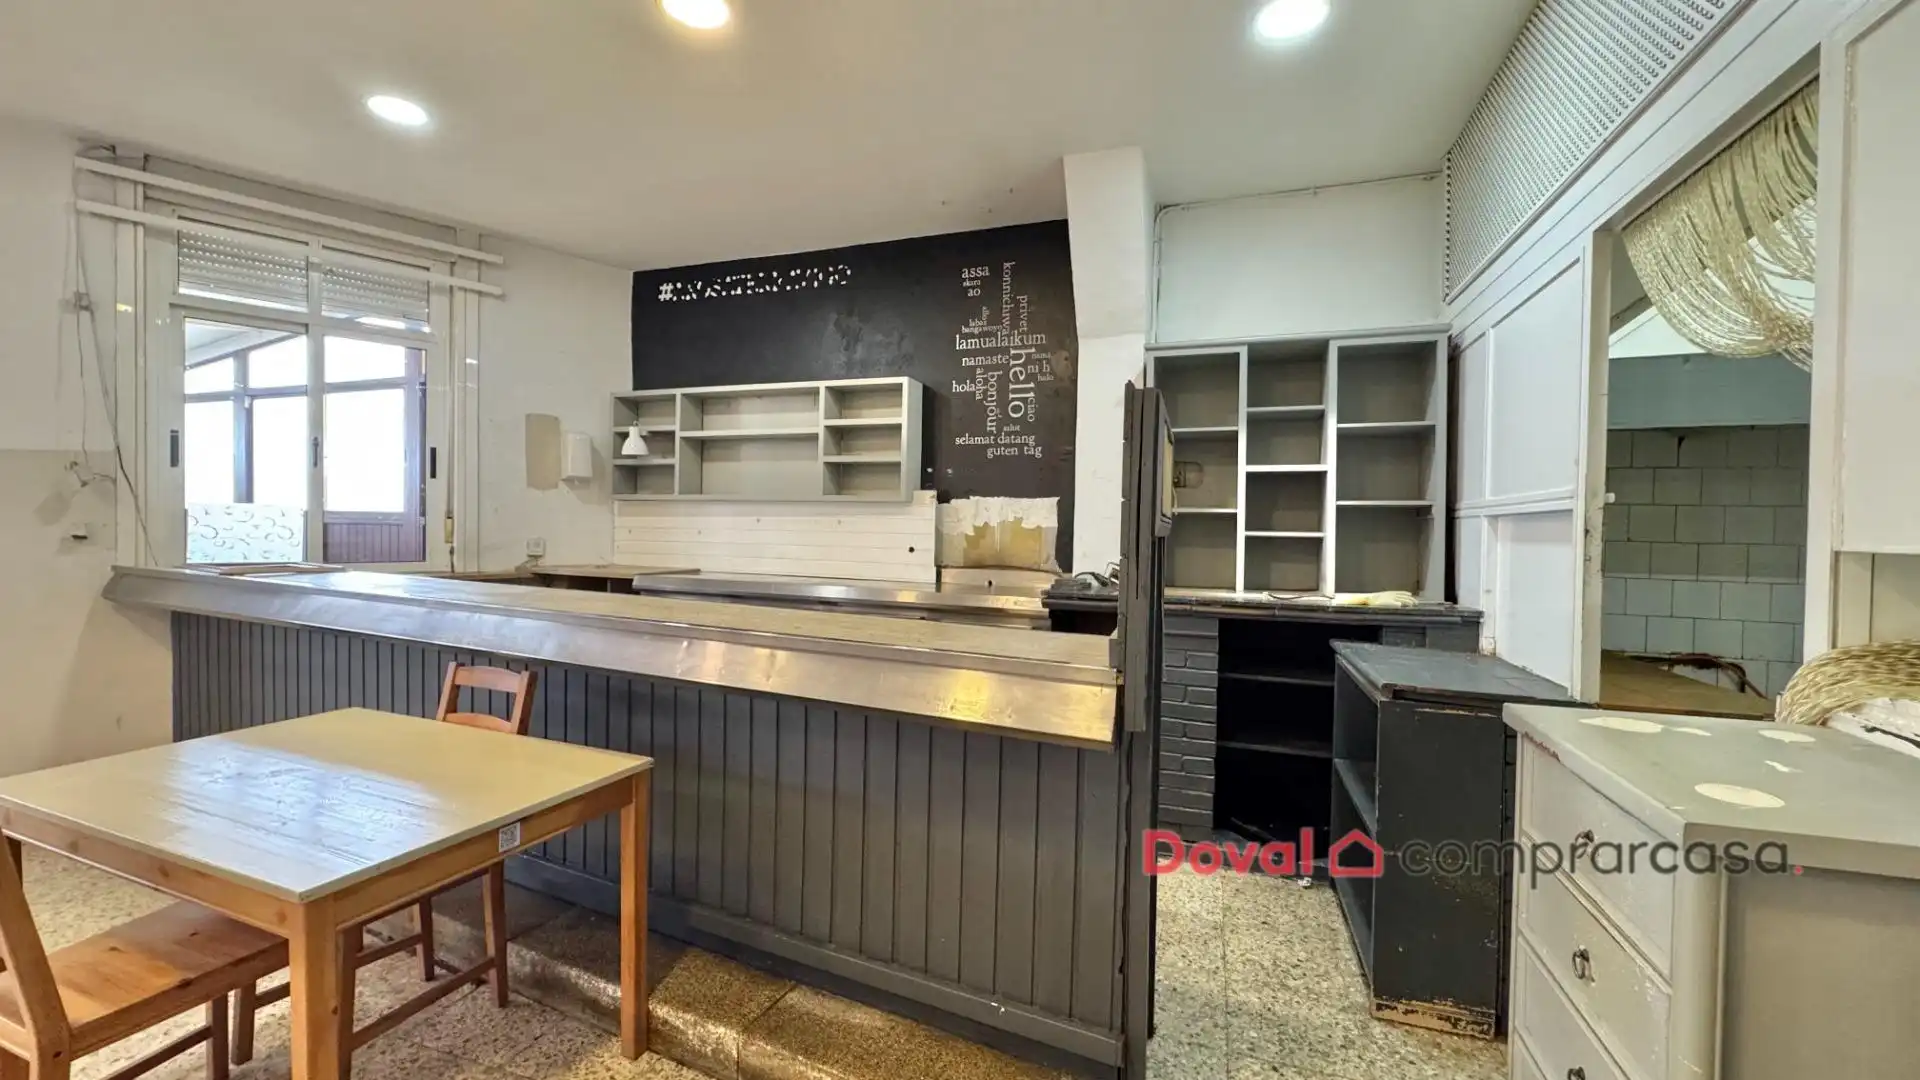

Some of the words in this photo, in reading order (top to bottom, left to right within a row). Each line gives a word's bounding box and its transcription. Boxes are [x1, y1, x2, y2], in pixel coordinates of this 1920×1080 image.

[961, 266, 990, 278] assa
[967, 288, 981, 297] ao
[1002, 261, 1016, 335] konnichiwa
[1017, 294, 1029, 332] privet
[955, 330, 1046, 350] lamualaikum
[962, 354, 1009, 366] namaste
[1028, 360, 1039, 373] ni
[952, 380, 976, 393] hola
[975, 367, 988, 401] aloha
[1008, 347, 1036, 418] hello
[983, 370, 1003, 434] bonjour
[1027, 397, 1038, 422] ciao
[955, 433, 995, 445] selamat
[997, 432, 1036, 447] datang
[986, 446, 1018, 459] guten
[1023, 445, 1043, 459] tag
